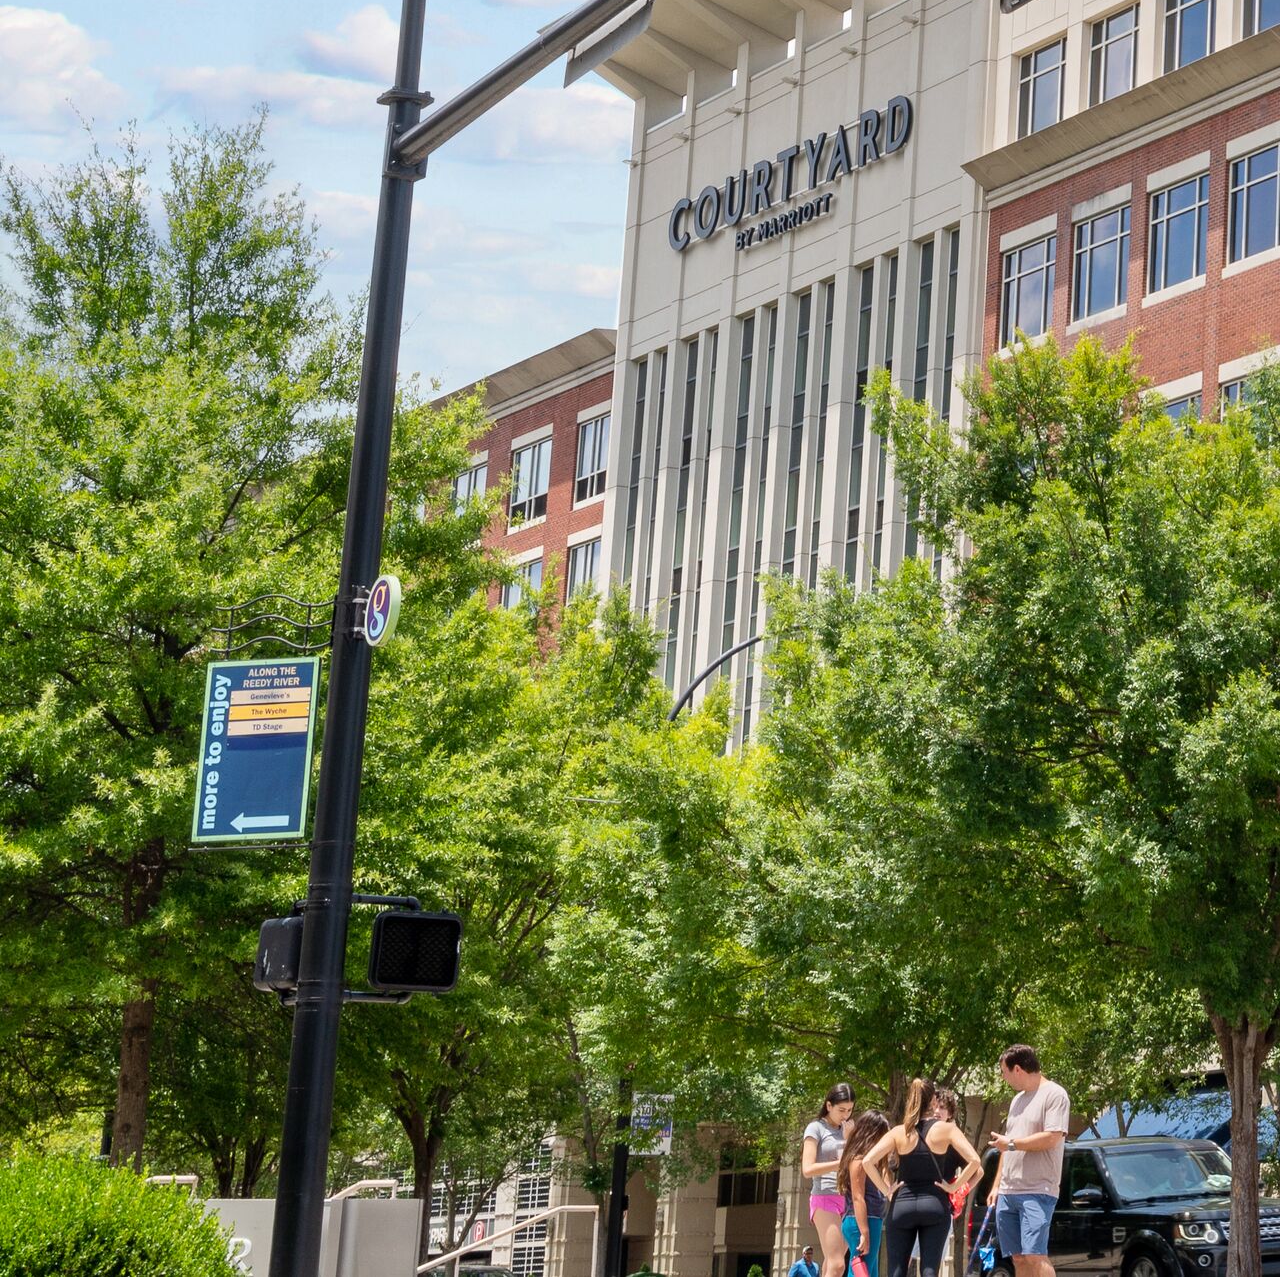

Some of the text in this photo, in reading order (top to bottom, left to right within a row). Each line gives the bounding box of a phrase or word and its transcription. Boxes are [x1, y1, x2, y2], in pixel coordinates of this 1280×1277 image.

[668, 94, 914, 251] COURTYARD
[735, 192, 833, 252] BY MARRIOTT
[247, 666, 297, 678] ALONG THE
[243, 676, 300, 688] REEDY RIVER
[250, 692, 291, 700] Genevieve's
[251, 707, 288, 717] The Wyche
[262, 723, 283, 731] Stage
[202, 674, 232, 830] more to enjoy
